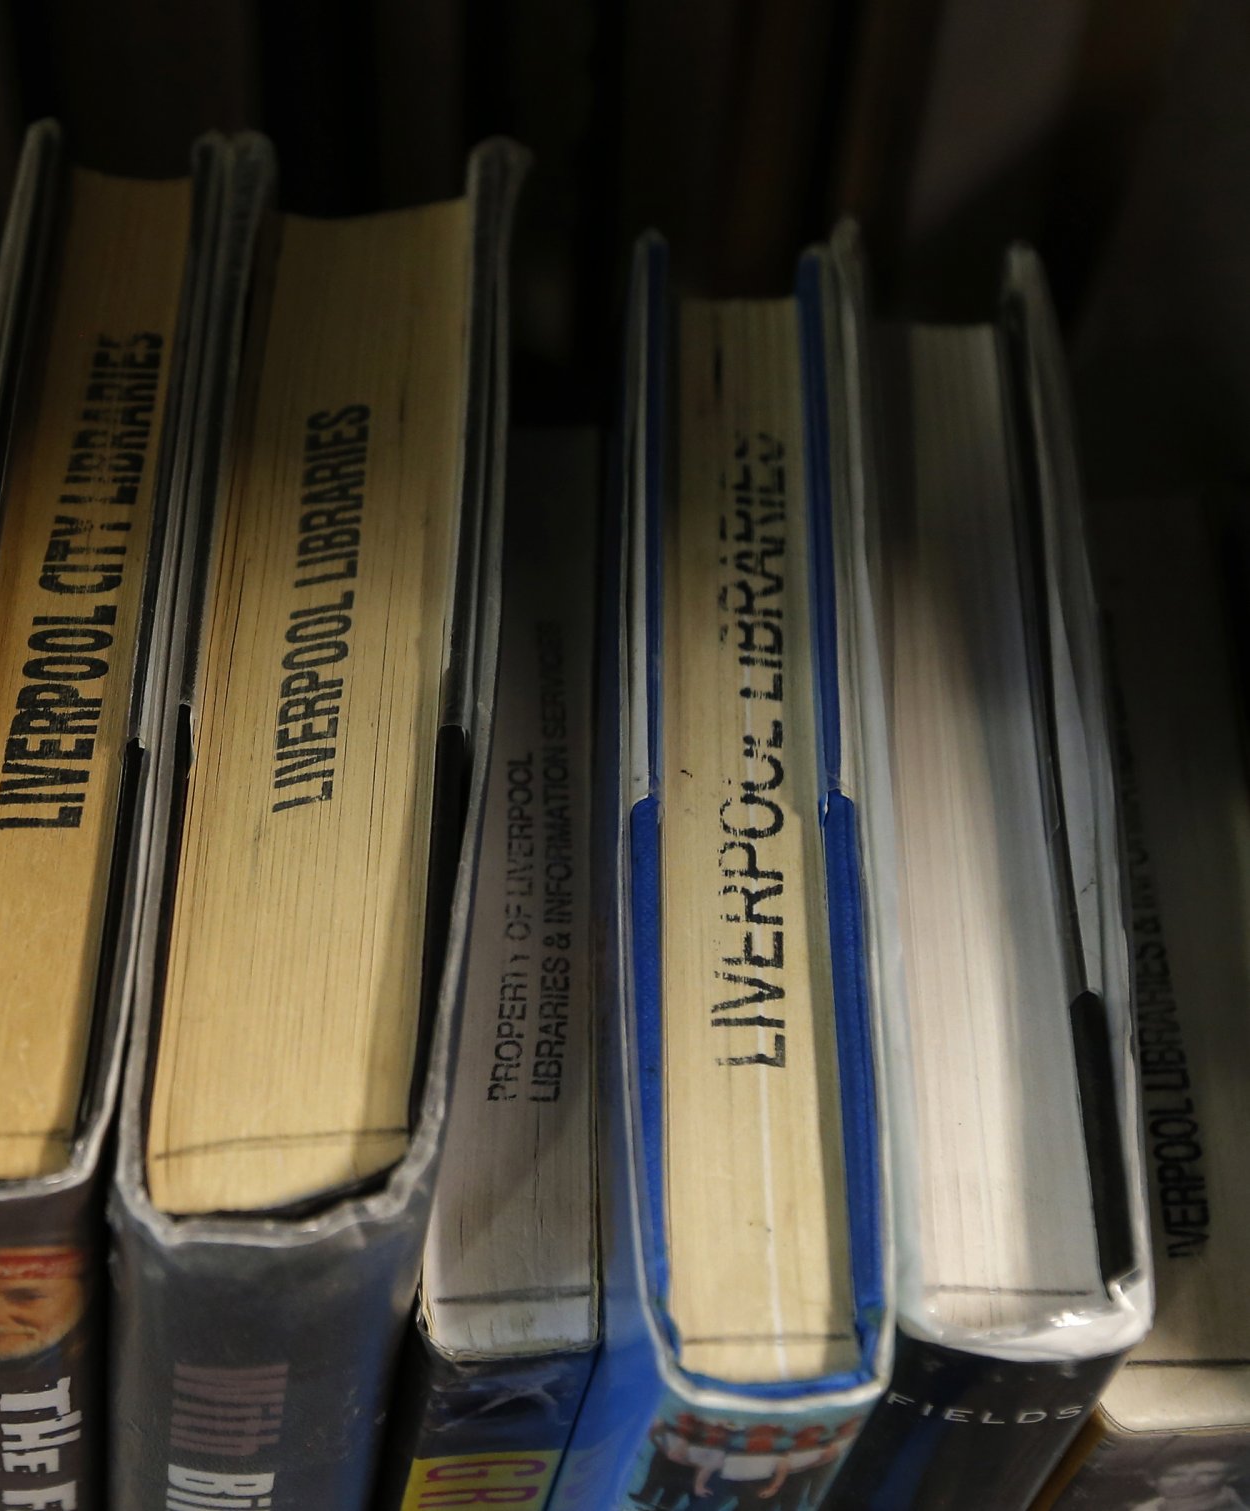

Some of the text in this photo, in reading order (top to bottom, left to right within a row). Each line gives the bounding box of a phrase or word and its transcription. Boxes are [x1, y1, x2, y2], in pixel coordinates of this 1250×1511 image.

[59, 330, 164, 506] LIBRARIES
[39, 513, 133, 594] CITY
[271, 403, 371, 813] LIVERPOOL LIBRARIES
[505, 751, 535, 897] LIVERPOOL
[541, 745, 574, 933] INFORMATION
[544, 934, 573, 953] &
[529, 957, 573, 1105] LIBRARIES
[885, 1390, 1085, 1425] FIELDS
